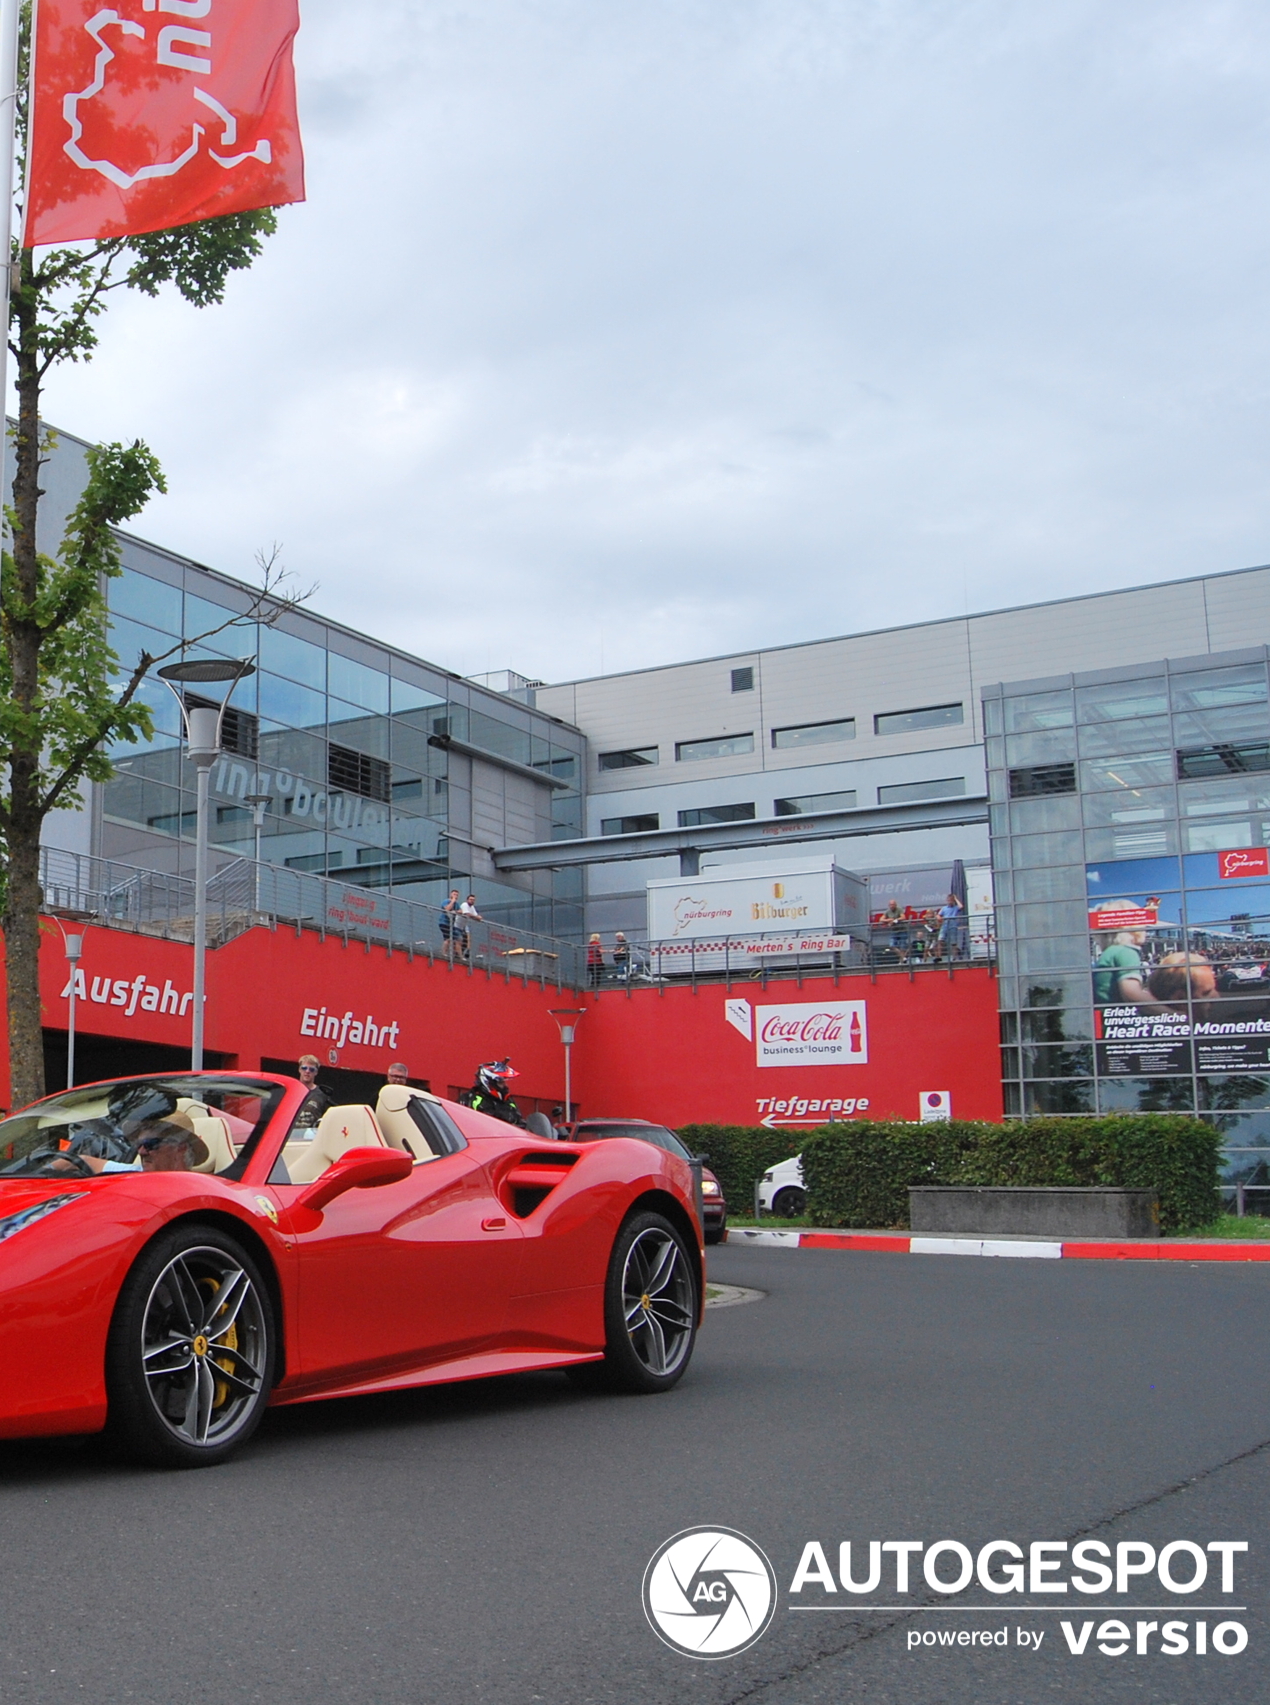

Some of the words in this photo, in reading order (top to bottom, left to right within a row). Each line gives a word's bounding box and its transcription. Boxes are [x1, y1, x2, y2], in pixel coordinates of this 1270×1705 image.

[683, 908, 733, 919] nürburgring
[750, 903, 808, 921] Bitburger
[800, 939, 824, 951] Ring
[827, 939, 846, 949] Bar
[60, 968, 207, 1017] Ausfahr
[1103, 1006, 1137, 1017] Erlebt
[1104, 1013, 1187, 1026] unvergessliche
[300, 1006, 400, 1050] Einfahrt
[1105, 1024, 1149, 1038] Heart
[1152, 1024, 1190, 1037] Race
[755, 1096, 870, 1117] Tiefgarage
